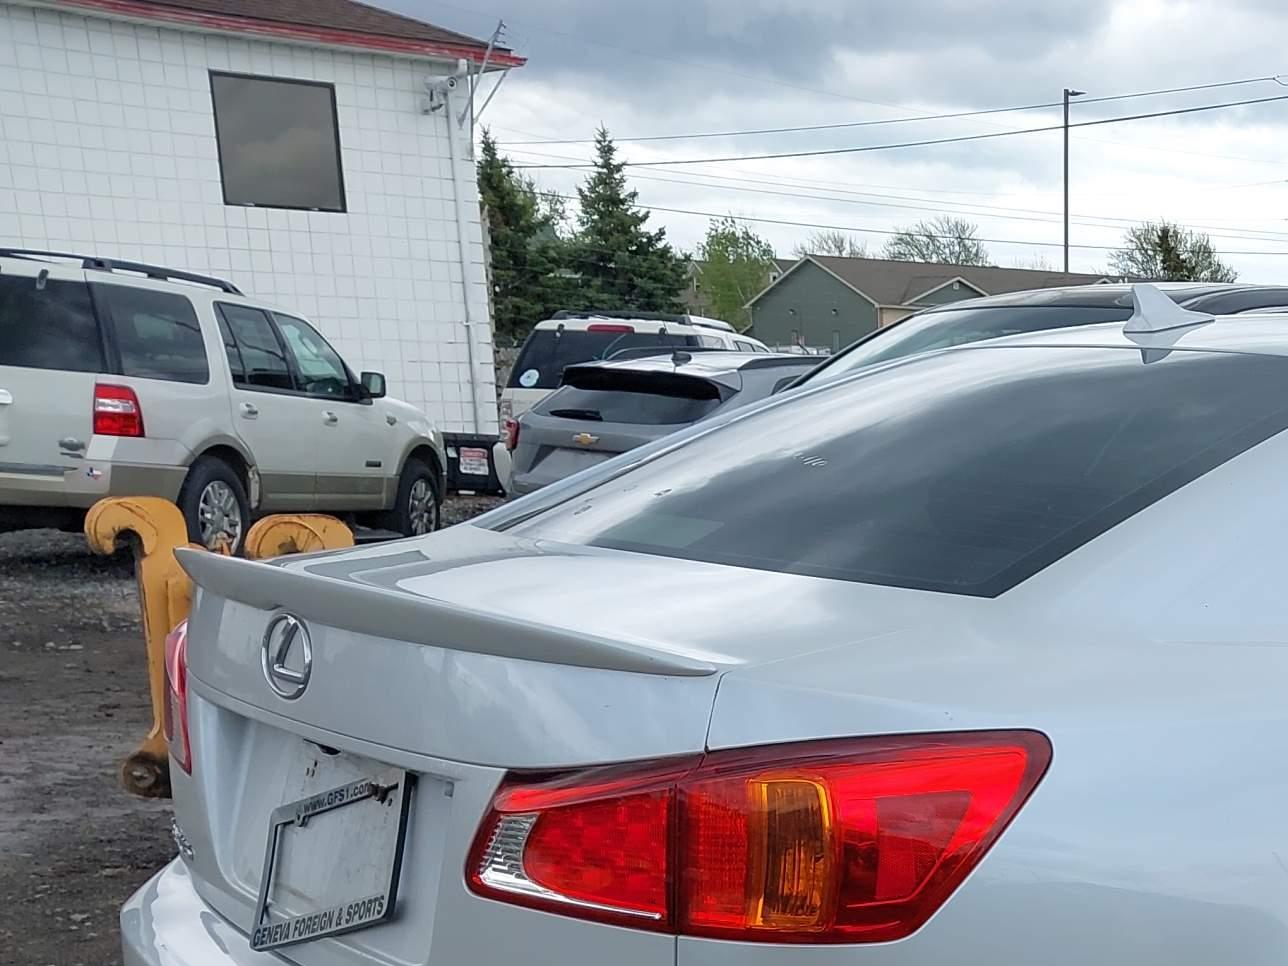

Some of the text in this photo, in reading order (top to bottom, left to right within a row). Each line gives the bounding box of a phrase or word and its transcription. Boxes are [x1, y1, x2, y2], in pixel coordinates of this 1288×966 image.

[253, 895, 385, 947] GENEVA FOREIGN & SPORTS
